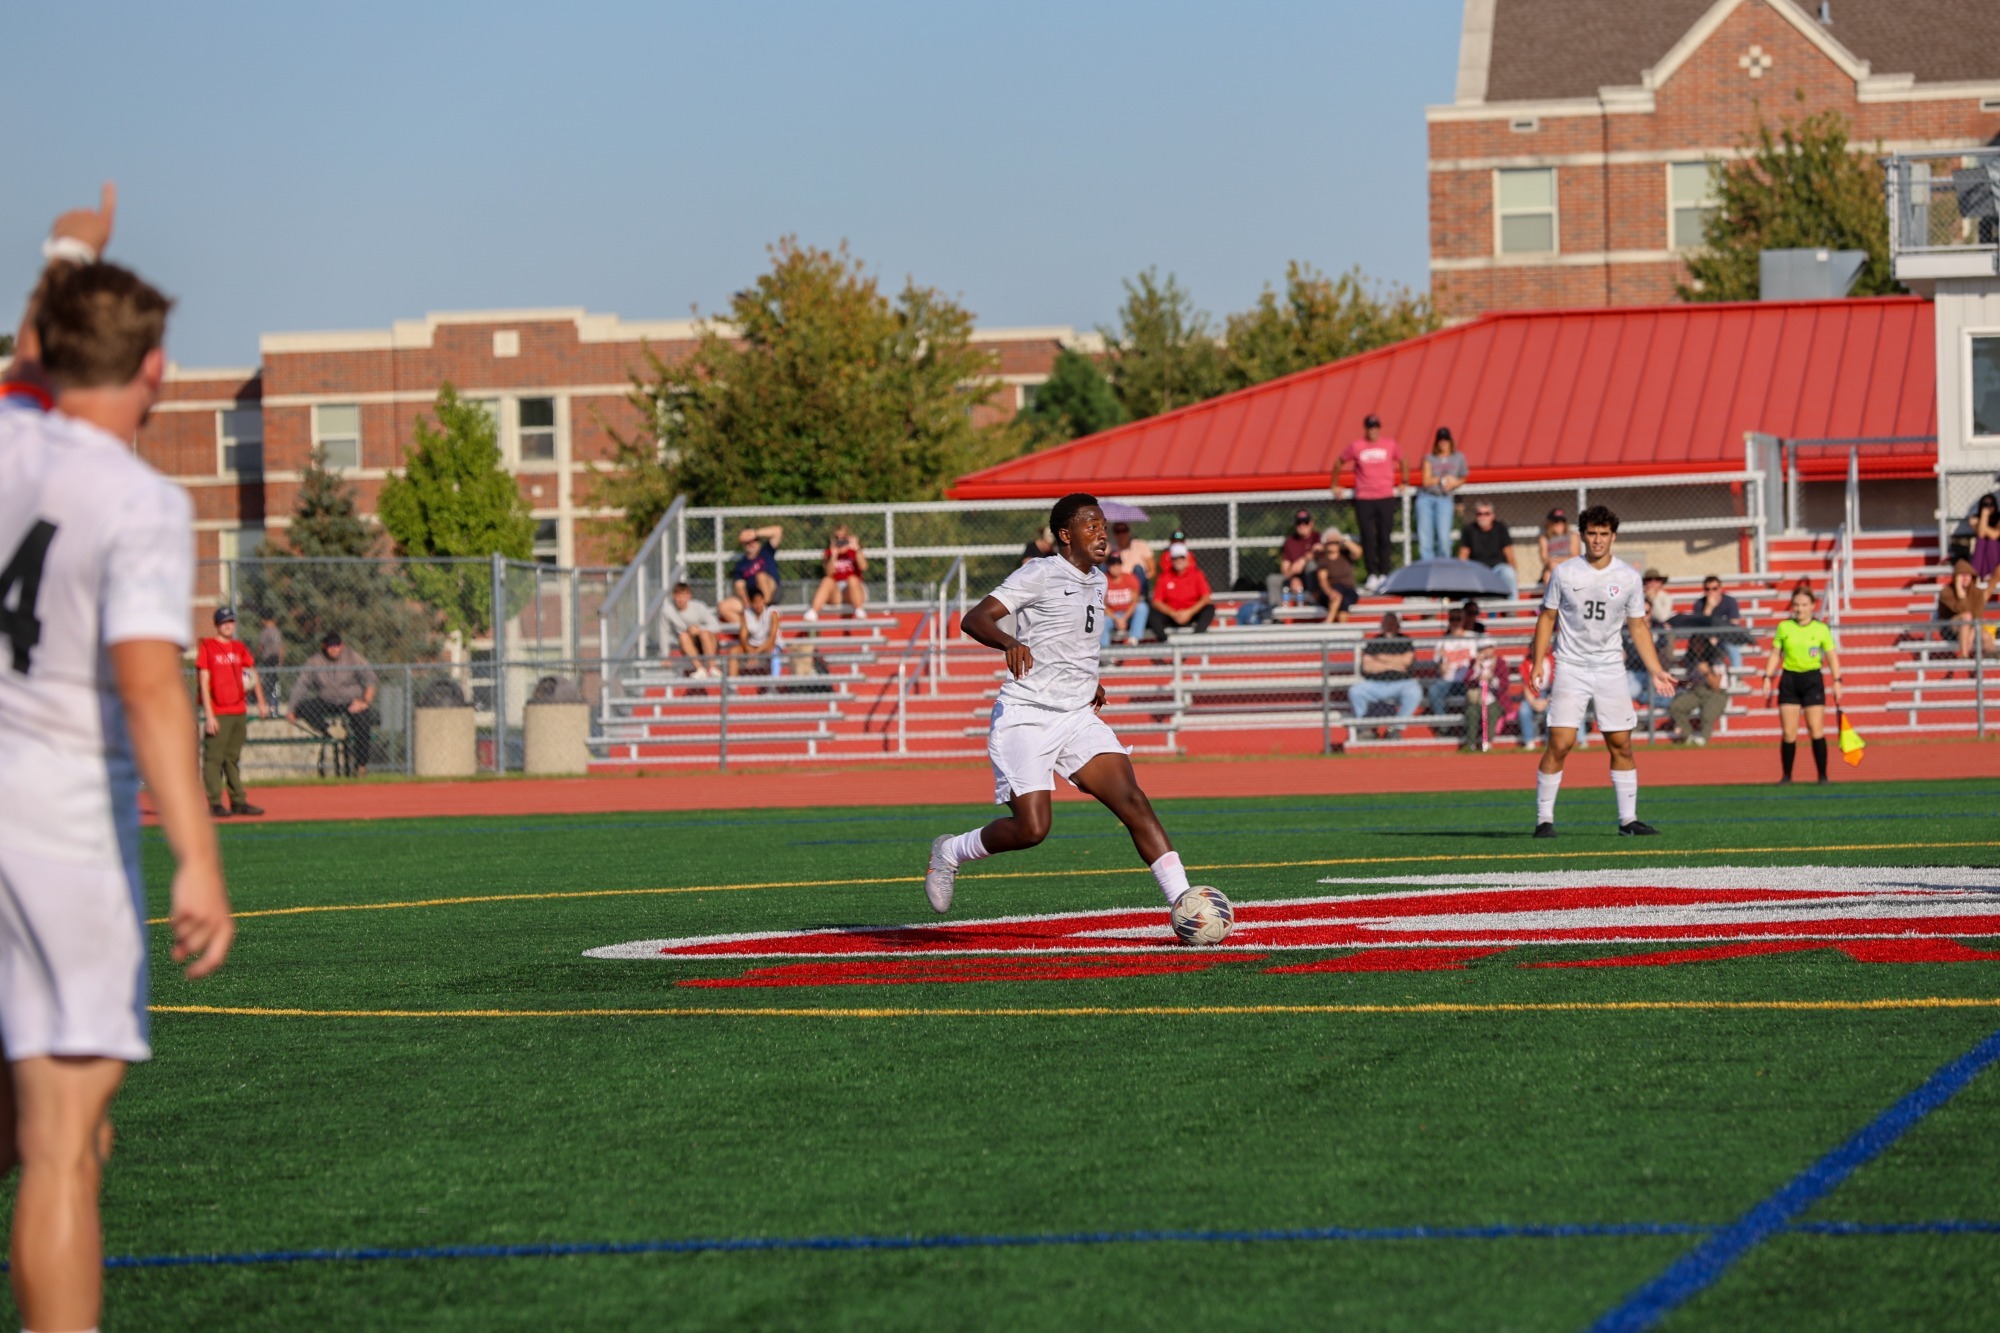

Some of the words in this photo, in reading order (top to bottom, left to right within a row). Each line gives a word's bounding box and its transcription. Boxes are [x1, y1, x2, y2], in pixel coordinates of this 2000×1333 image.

[0, 519, 58, 675] 4
[1583, 600, 1606, 621] 35
[1085, 604, 1095, 634] 6
